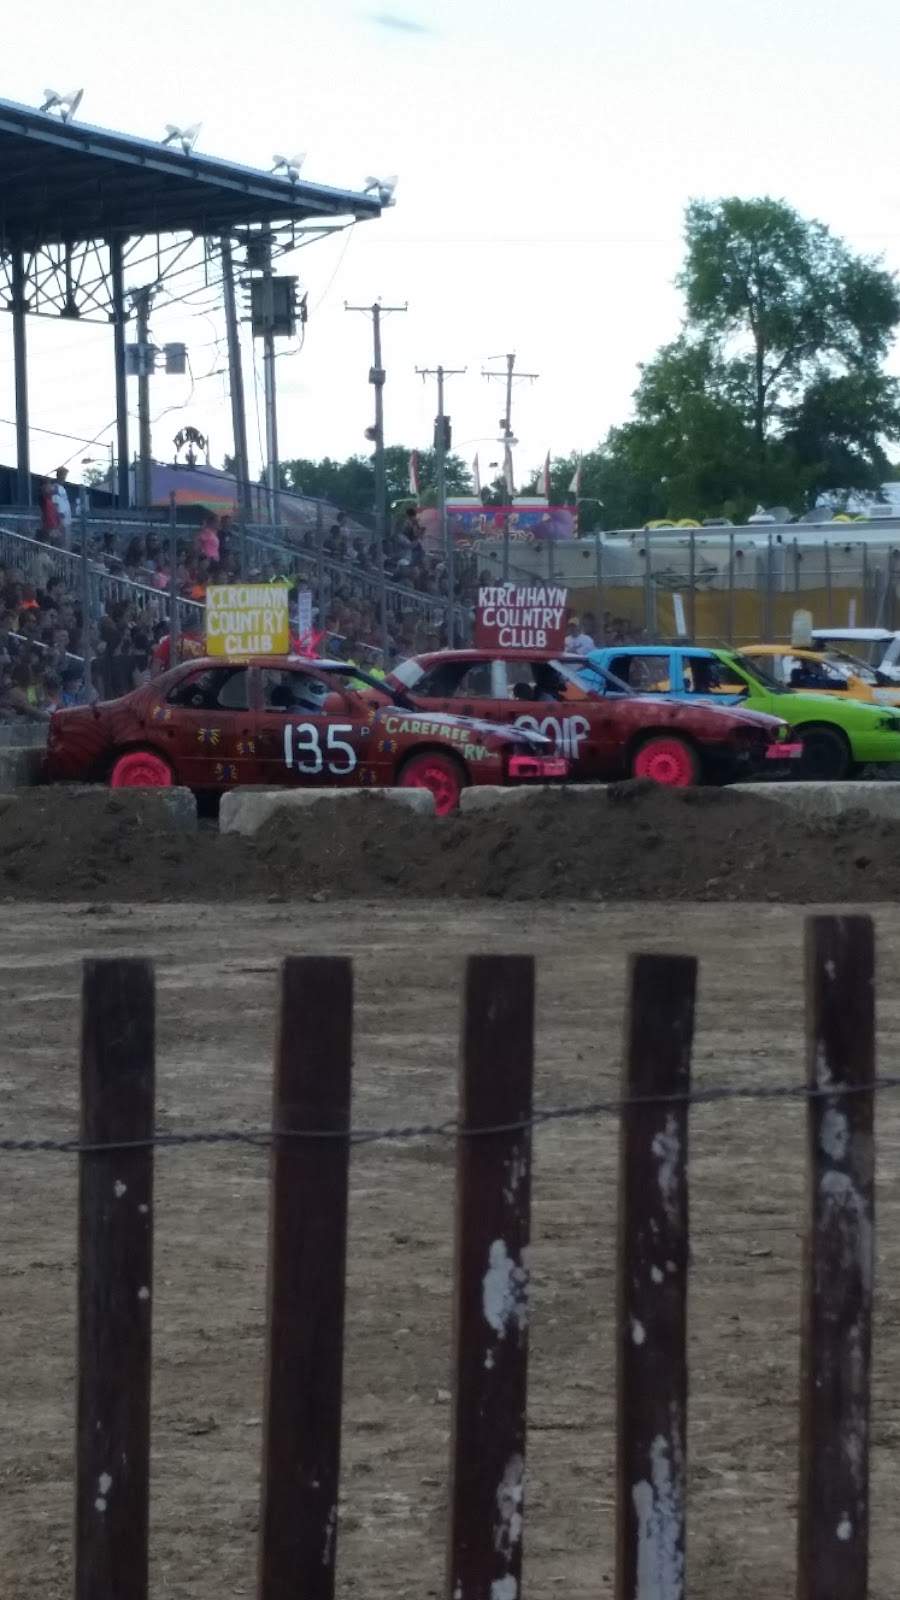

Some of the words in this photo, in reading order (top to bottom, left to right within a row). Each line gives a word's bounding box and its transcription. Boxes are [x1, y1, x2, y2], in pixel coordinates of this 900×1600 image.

[478, 583, 567, 607] KIRCHHAYN
[207, 610, 284, 635] COUNTRY
[482, 607, 564, 630] COUNTRY
[224, 635, 273, 655] CLUB
[498, 628, 547, 648] CLUB
[283, 723, 357, 774] 135
